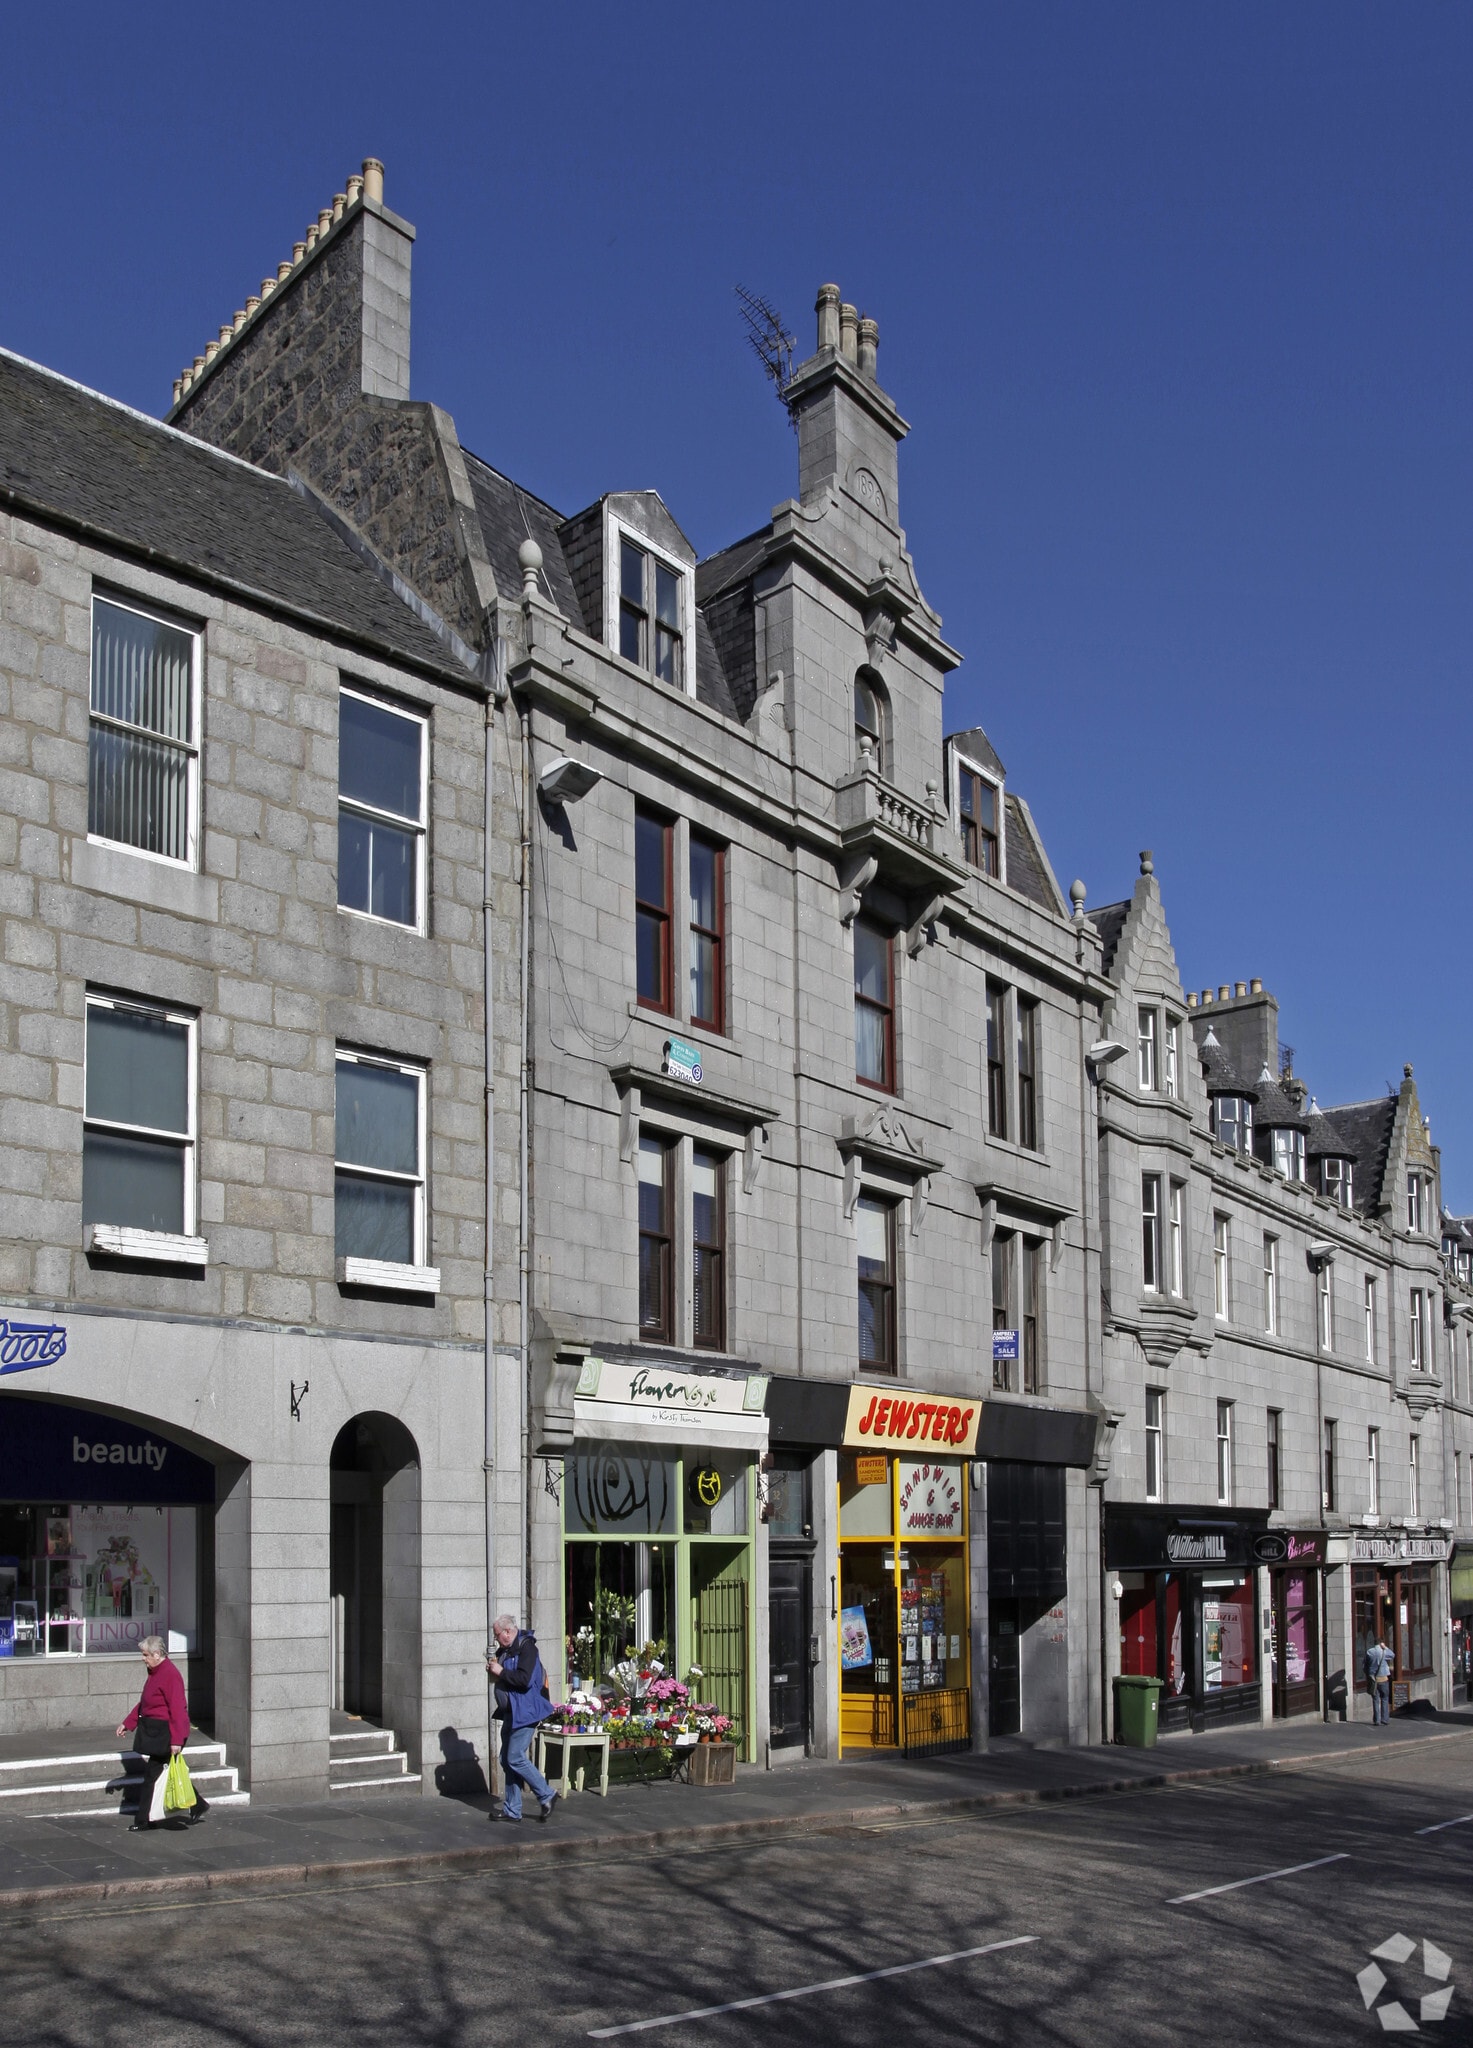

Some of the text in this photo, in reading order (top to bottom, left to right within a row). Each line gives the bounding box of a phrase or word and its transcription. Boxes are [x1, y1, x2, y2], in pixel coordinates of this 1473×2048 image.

[859, 1396, 974, 1446] JEWSTERS
[73, 1435, 167, 1471] beauty
[907, 1513, 954, 1529] JUICE BAR
[1167, 1535, 1227, 1559] William HILL
[1356, 1541, 1393, 1556] WORDIES
[76, 1621, 164, 1641] CLINIQUE
